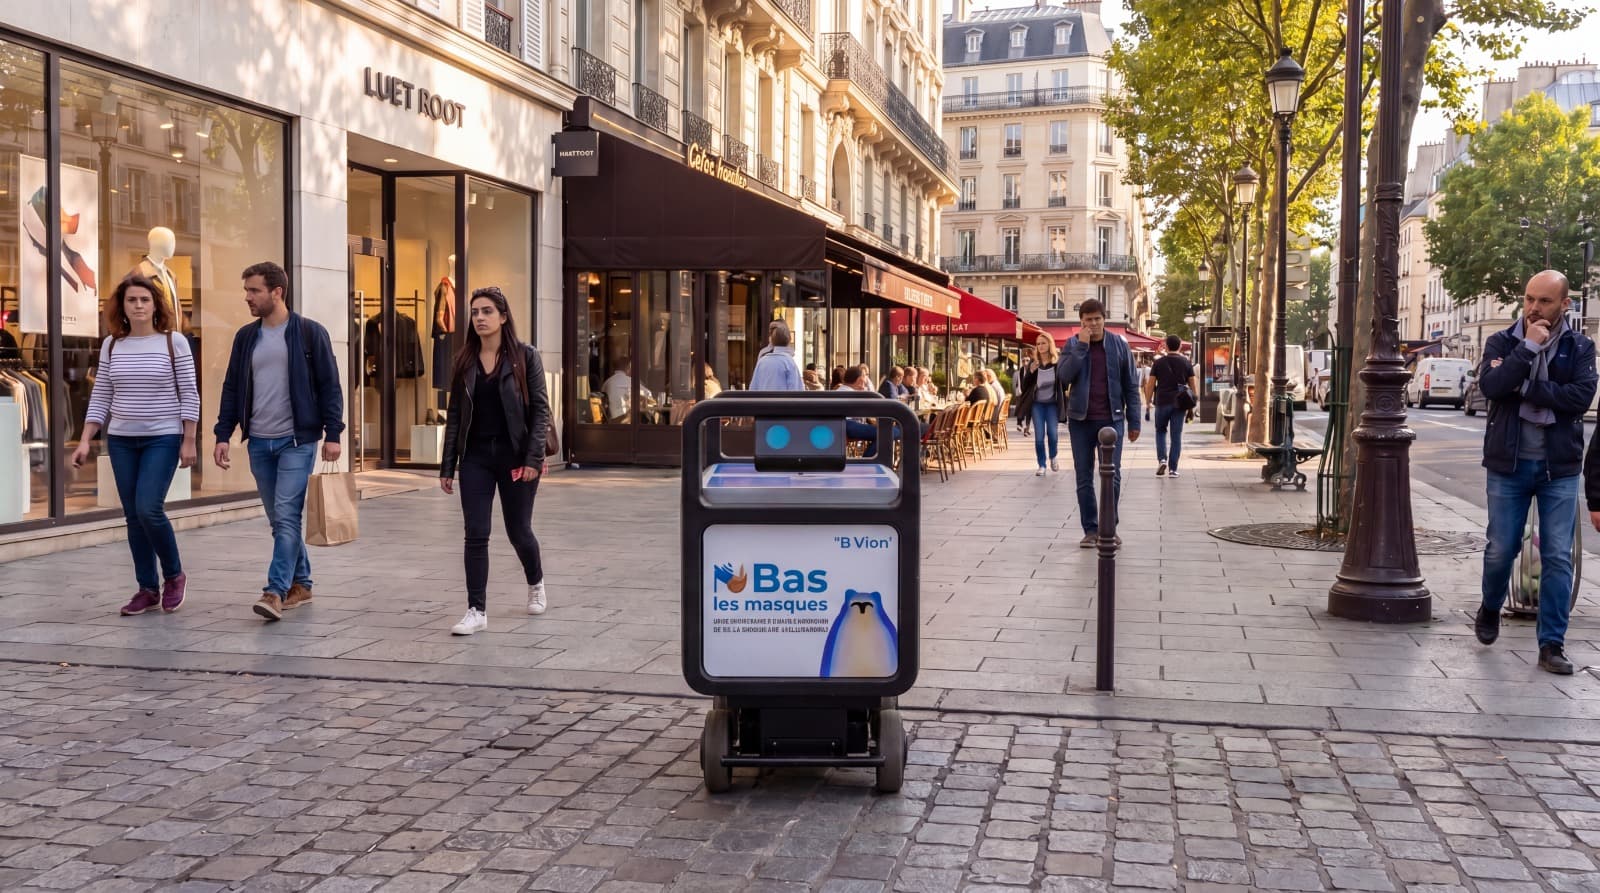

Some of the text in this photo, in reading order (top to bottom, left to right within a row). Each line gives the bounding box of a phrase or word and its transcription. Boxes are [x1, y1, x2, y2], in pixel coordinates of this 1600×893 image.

[363, 66, 466, 129] LUET ROOT
[753, 563, 828, 593] Bas
[713, 595, 828, 614] les masques
